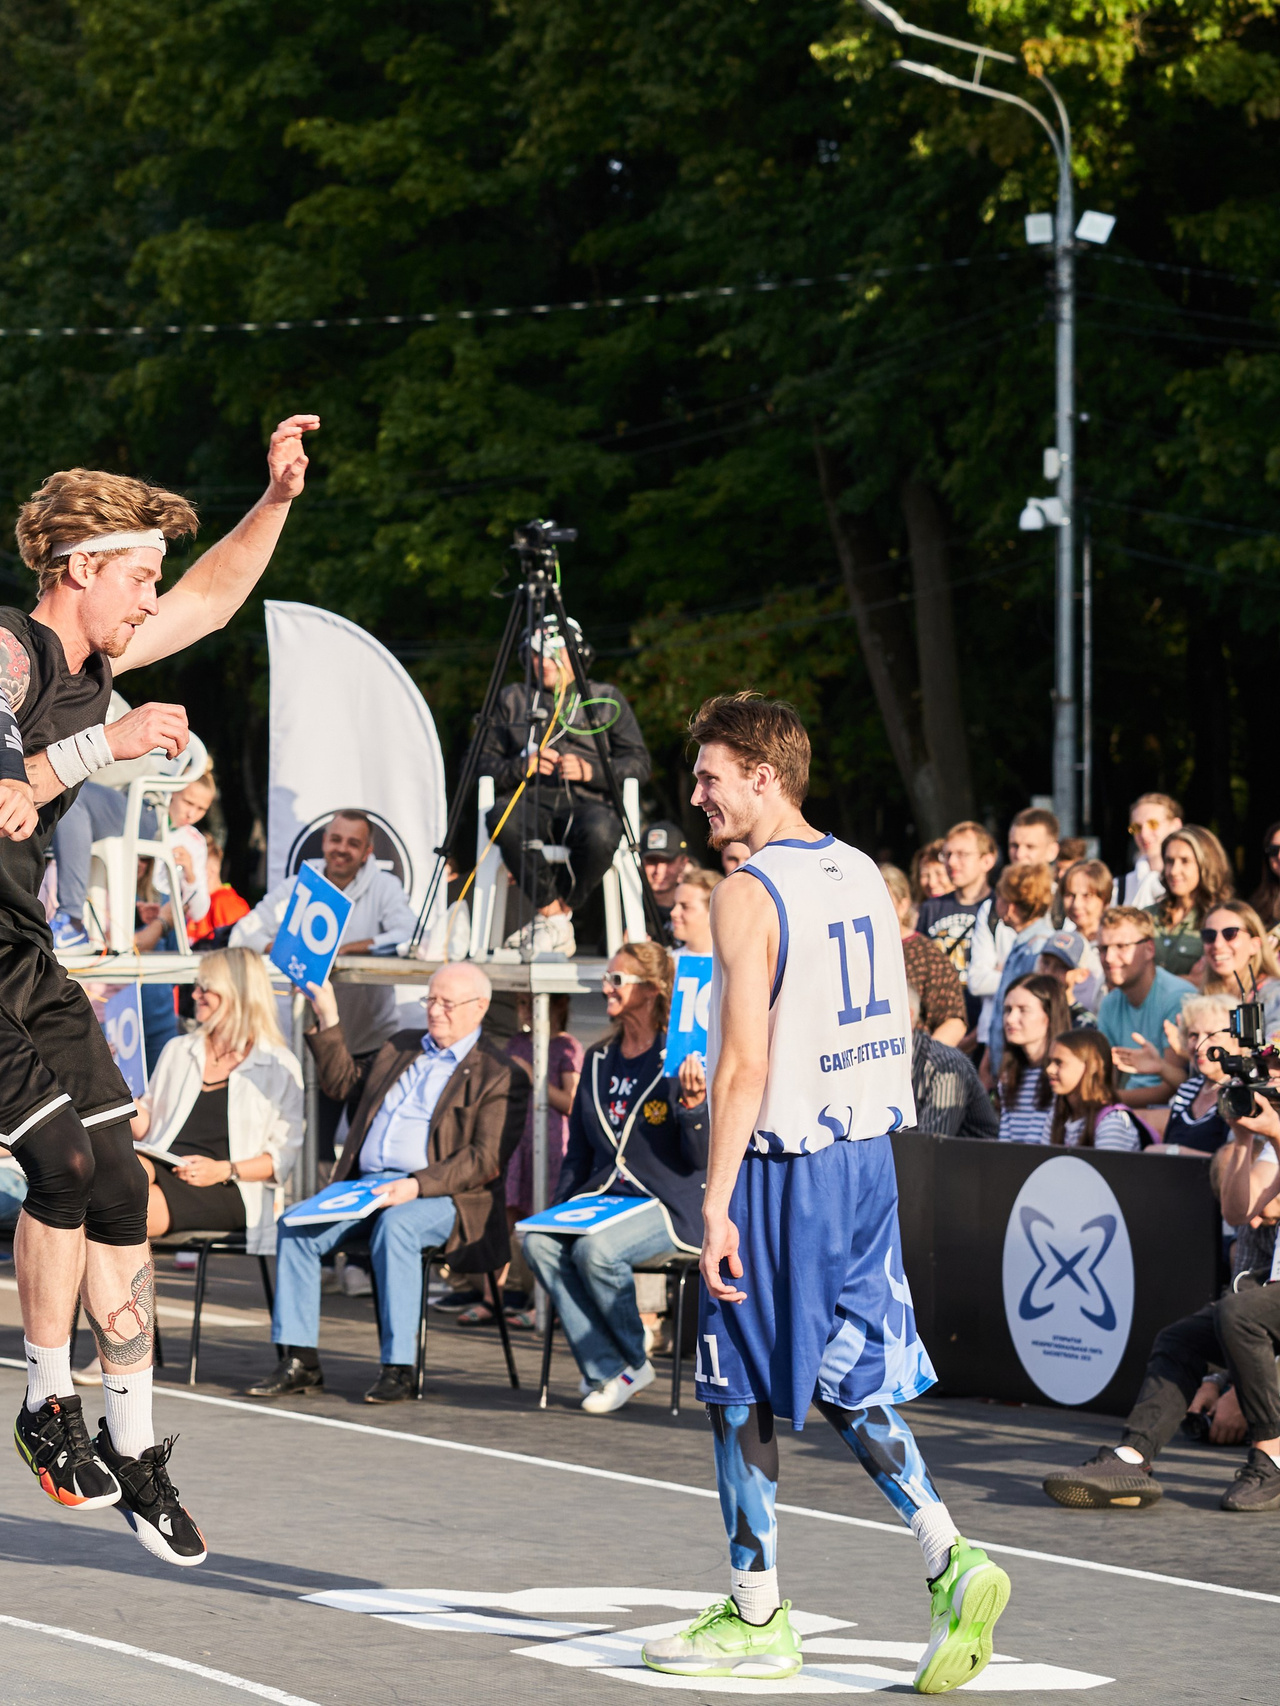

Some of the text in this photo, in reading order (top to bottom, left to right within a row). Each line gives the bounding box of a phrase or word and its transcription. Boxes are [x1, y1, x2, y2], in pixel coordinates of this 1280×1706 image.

[287, 882, 339, 956] 10
[828, 915, 891, 1026] 11
[694, 1334, 729, 1387] 11
